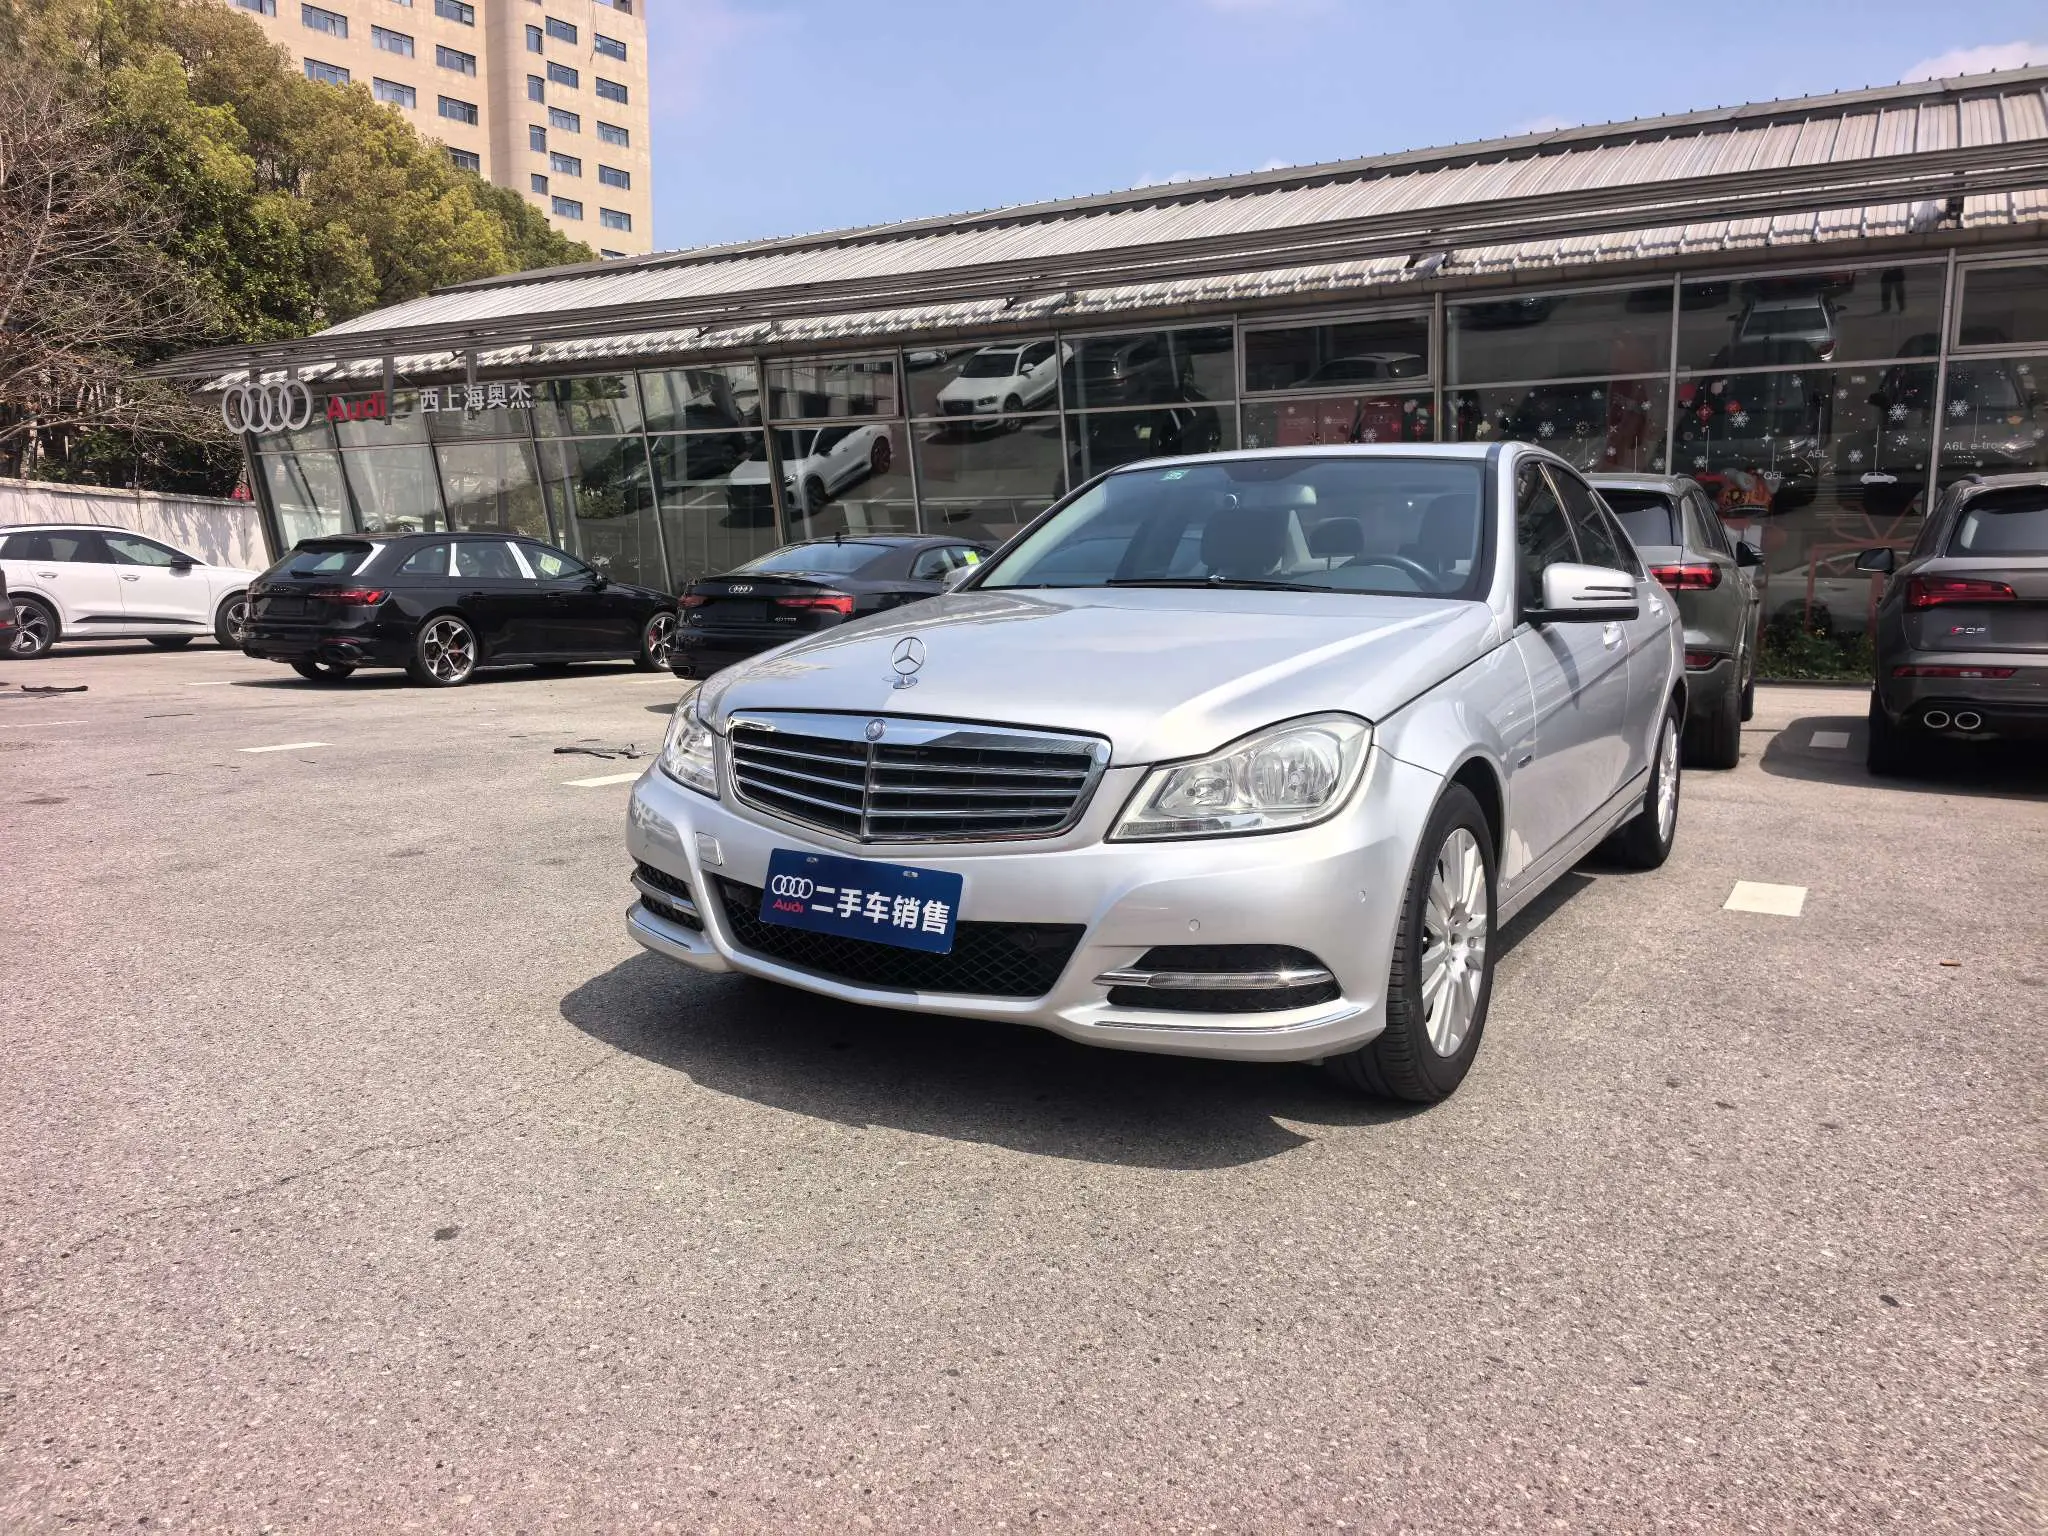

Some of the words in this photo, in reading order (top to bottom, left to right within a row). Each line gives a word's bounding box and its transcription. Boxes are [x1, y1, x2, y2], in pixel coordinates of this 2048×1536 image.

[326, 392, 385, 421] Audi
[420, 381, 533, 414] 西上海奥杰
[772, 898, 805, 914] Audi
[811, 885, 951, 935] 二手车销售
